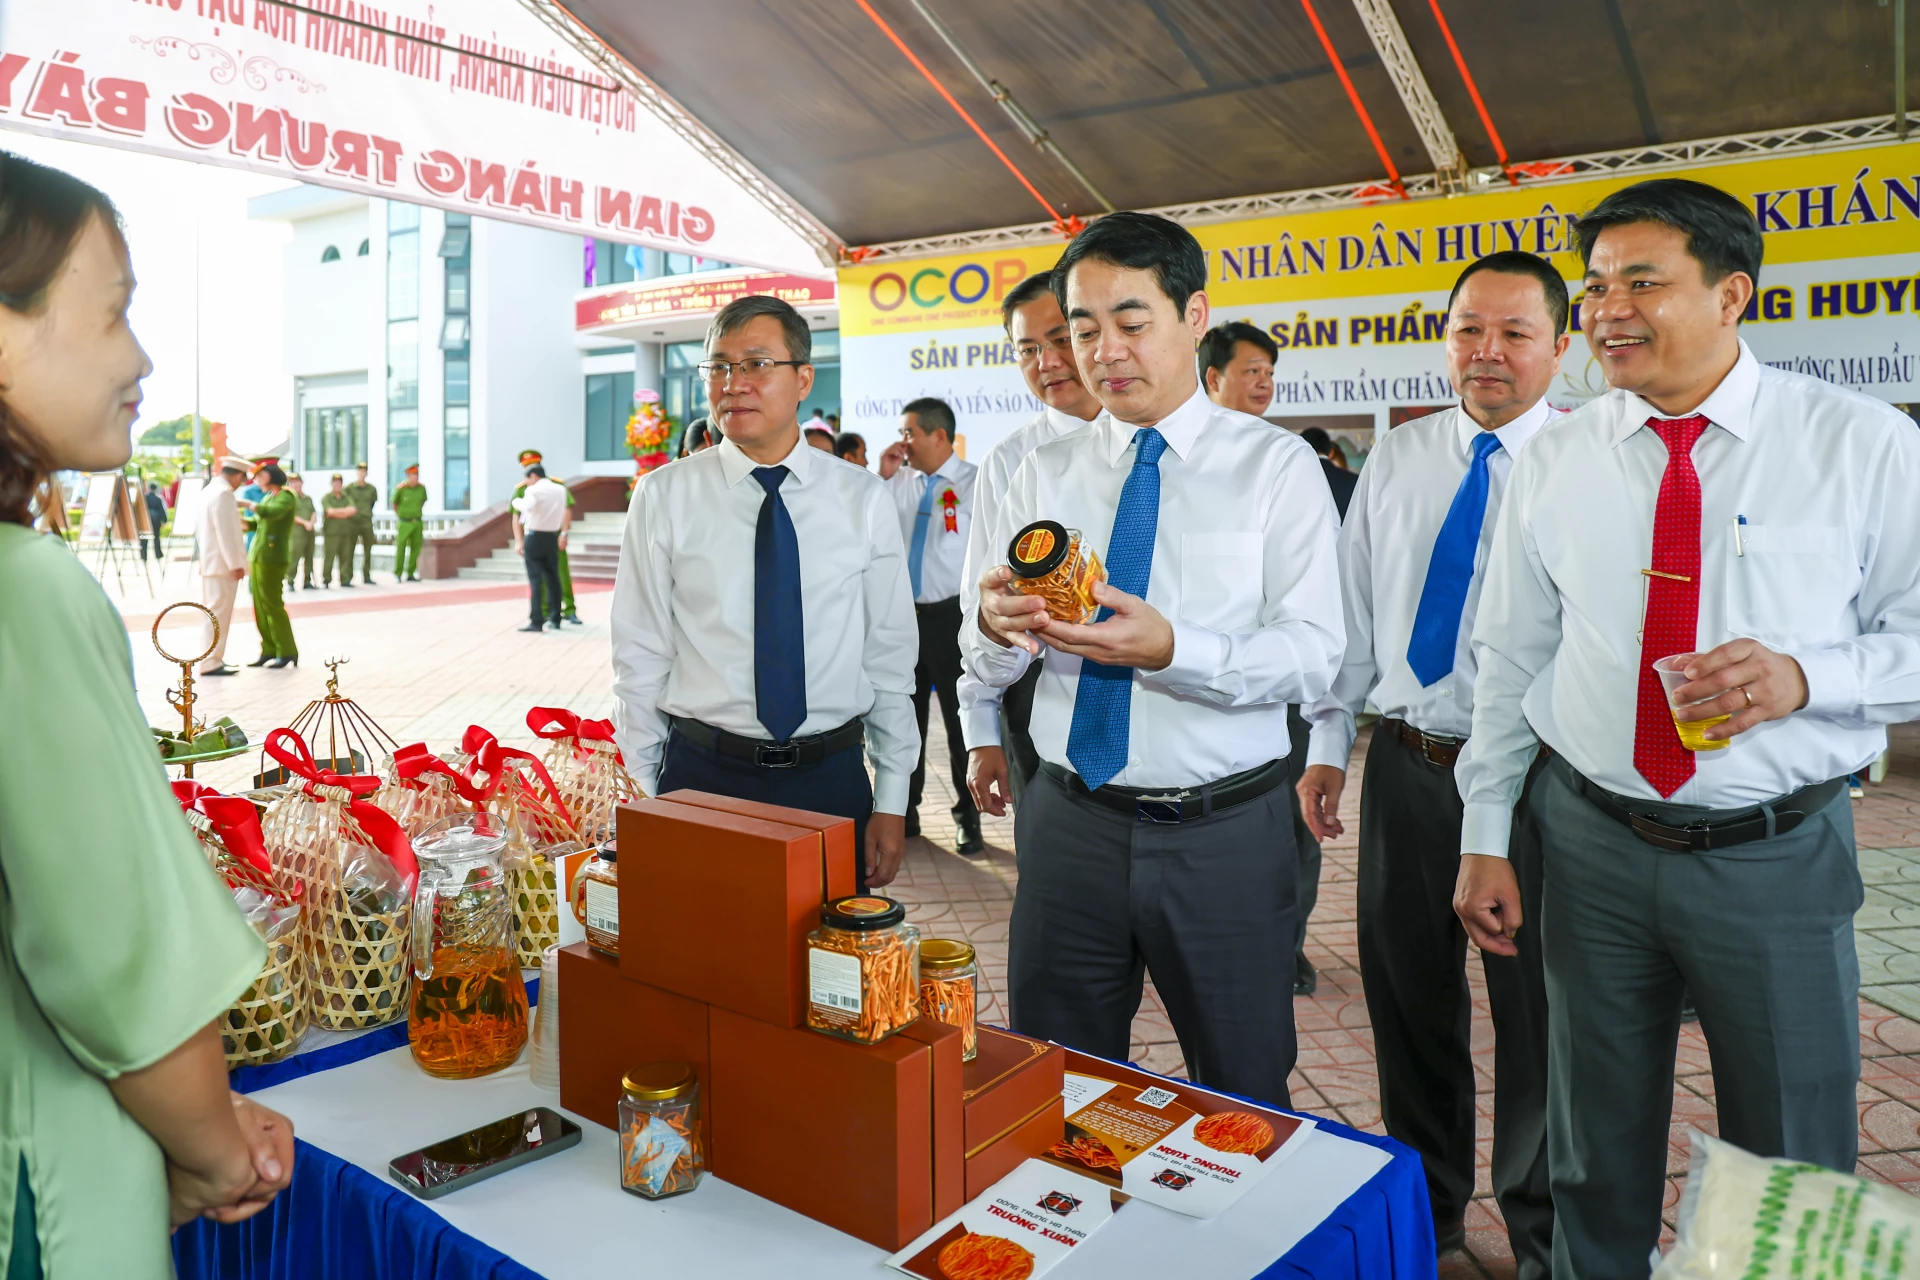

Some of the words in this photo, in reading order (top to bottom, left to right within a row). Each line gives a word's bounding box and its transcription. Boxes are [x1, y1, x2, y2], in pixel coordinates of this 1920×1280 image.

[1221, 232, 1327, 282] NHÂN
[1337, 222, 1423, 272] DÂN
[777, 288, 811, 301] THAO
[869, 258, 1028, 311] OCOP
[910, 339, 959, 371] SẢN
[1270, 310, 1339, 350] SẢN
[1350, 301, 1450, 345] PHẨM
[1330, 367, 1387, 403] TRẦM
[1393, 371, 1455, 401] CHĂM
[1839, 357, 1873, 392] MẠI
[1878, 341, 1915, 384] ĐẦU
